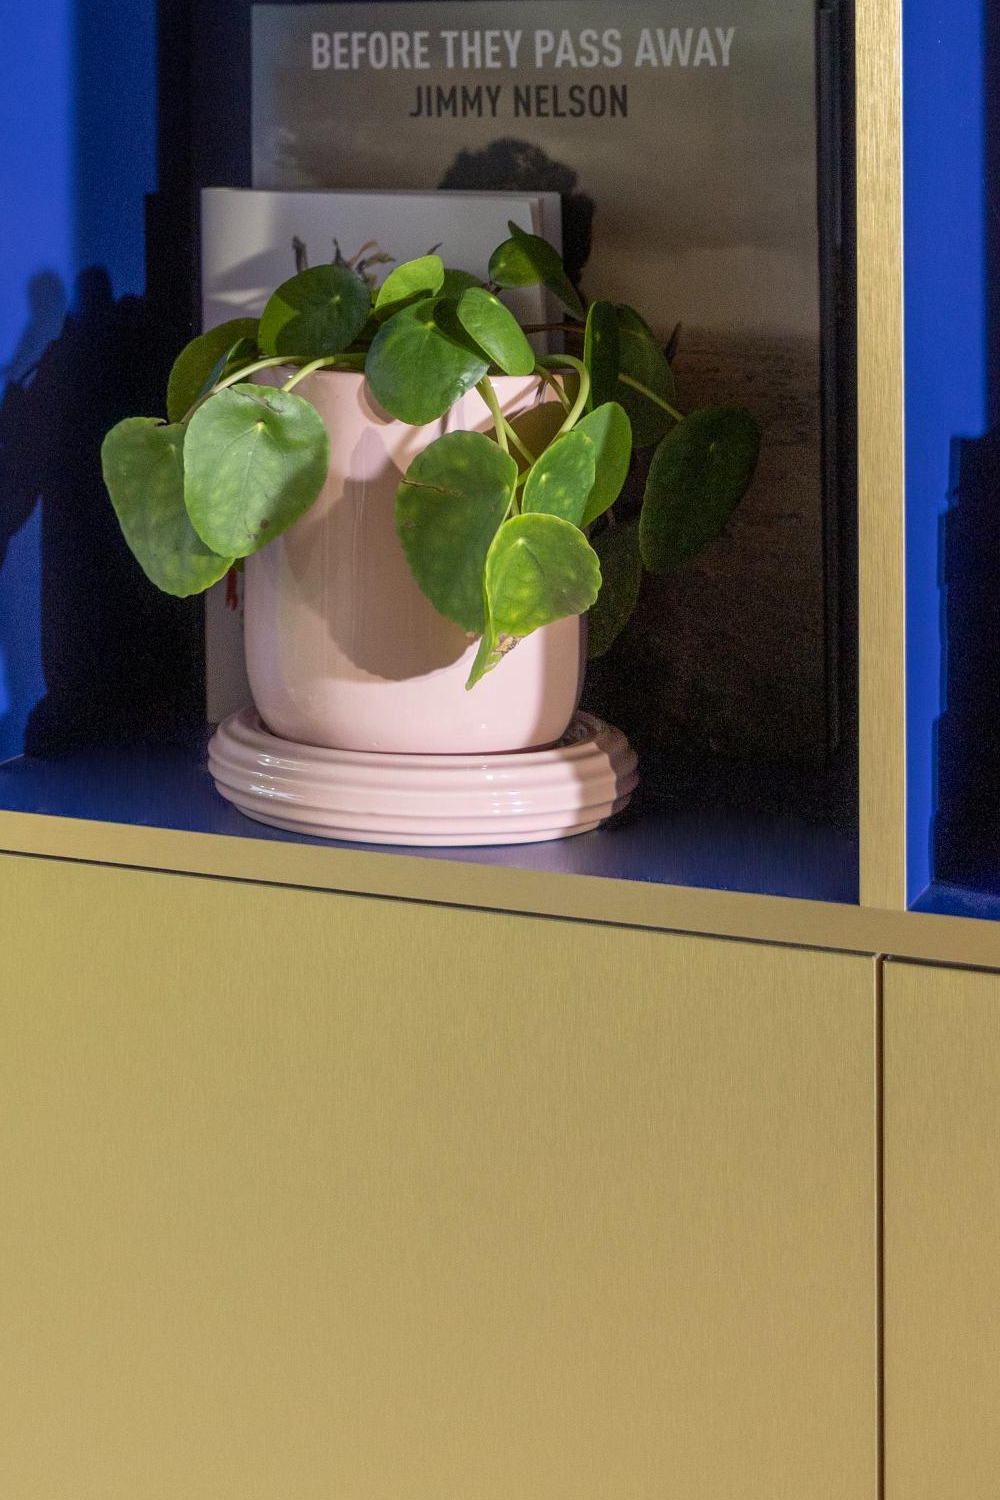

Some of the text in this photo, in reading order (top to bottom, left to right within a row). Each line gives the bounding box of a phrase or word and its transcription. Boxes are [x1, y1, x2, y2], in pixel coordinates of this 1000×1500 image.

[310, 27, 736, 71] BEFORE THEY PASS AWAY
[408, 84, 629, 118] JIMMY NELSON
